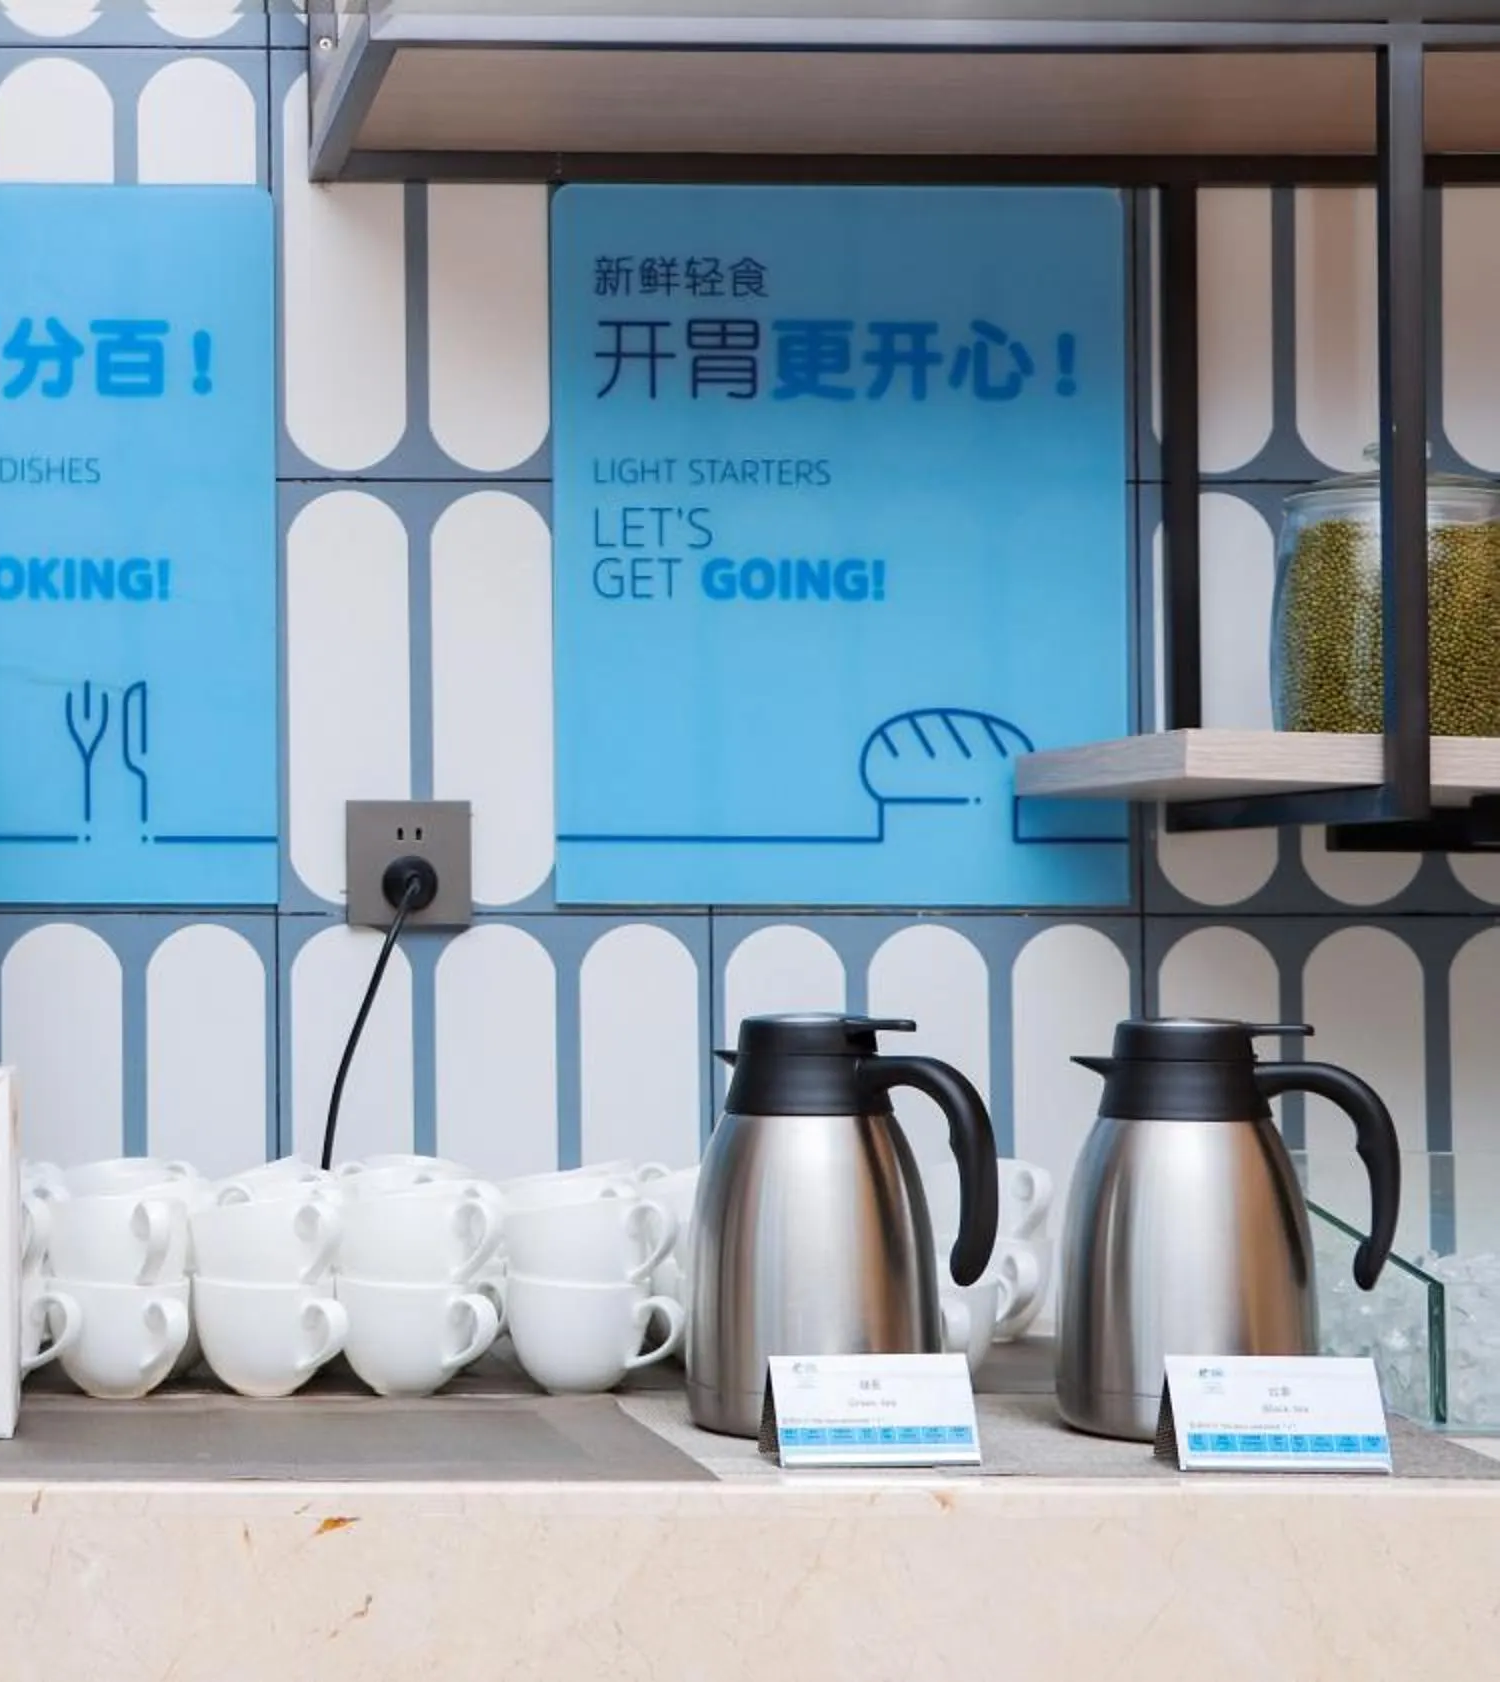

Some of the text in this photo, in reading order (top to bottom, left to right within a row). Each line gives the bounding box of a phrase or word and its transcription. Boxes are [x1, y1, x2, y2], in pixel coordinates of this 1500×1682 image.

[593, 255, 770, 299] 新鲜轻食
[0, 457, 101, 484] DISHES
[593, 458, 832, 487] LIGHT STARTERS
[594, 507, 713, 549] LET'S
[593, 557, 886, 601] GET GOING!
